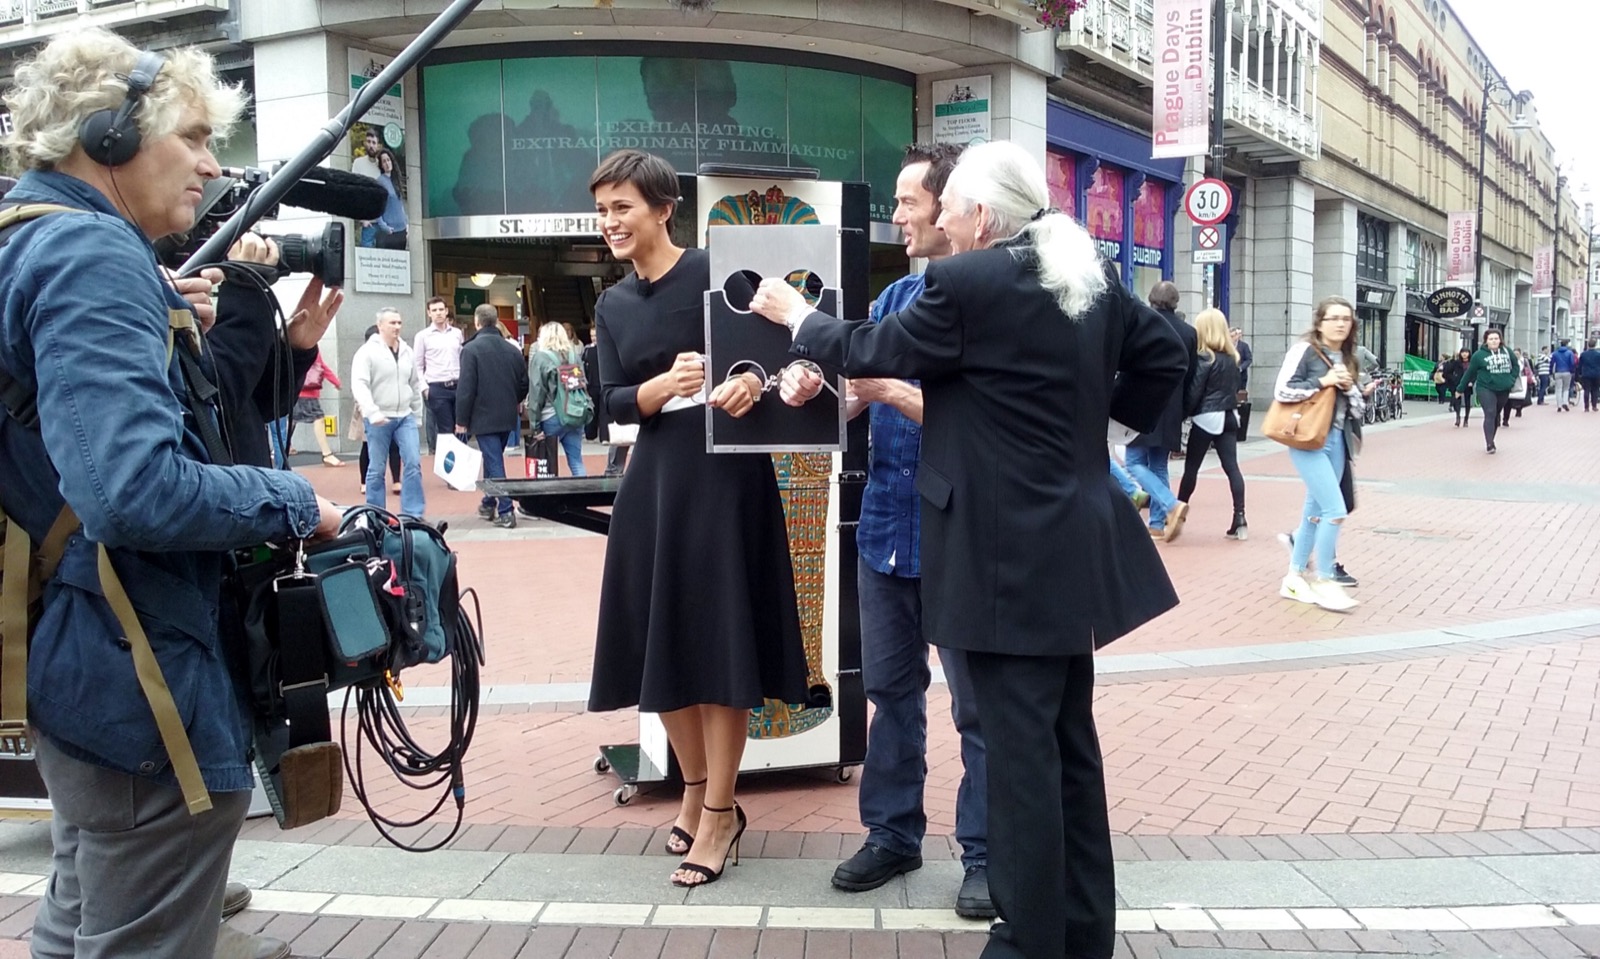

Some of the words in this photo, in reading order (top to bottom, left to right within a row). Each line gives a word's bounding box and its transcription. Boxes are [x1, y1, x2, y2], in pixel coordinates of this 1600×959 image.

[1162, 10, 1184, 63] Days
[1185, 8, 1202, 80] Dublin
[1155, 69, 1184, 146] Prague
[511, 136, 711, 151] EXTRAORDINARY
[1197, 190, 1220, 210] 30
[1198, 211, 1217, 219] km/h
[499, 219, 525, 234] ST.
[1452, 219, 1462, 243] Days
[1462, 219, 1472, 252] Dublin
[1094, 239, 1120, 259] wamp
[1134, 246, 1162, 266] swamp
[1448, 247, 1460, 281] Prague
[1431, 290, 1469, 306] SINNOTTS
[1439, 306, 1460, 314] BAR
[324, 418, 333, 433] H
